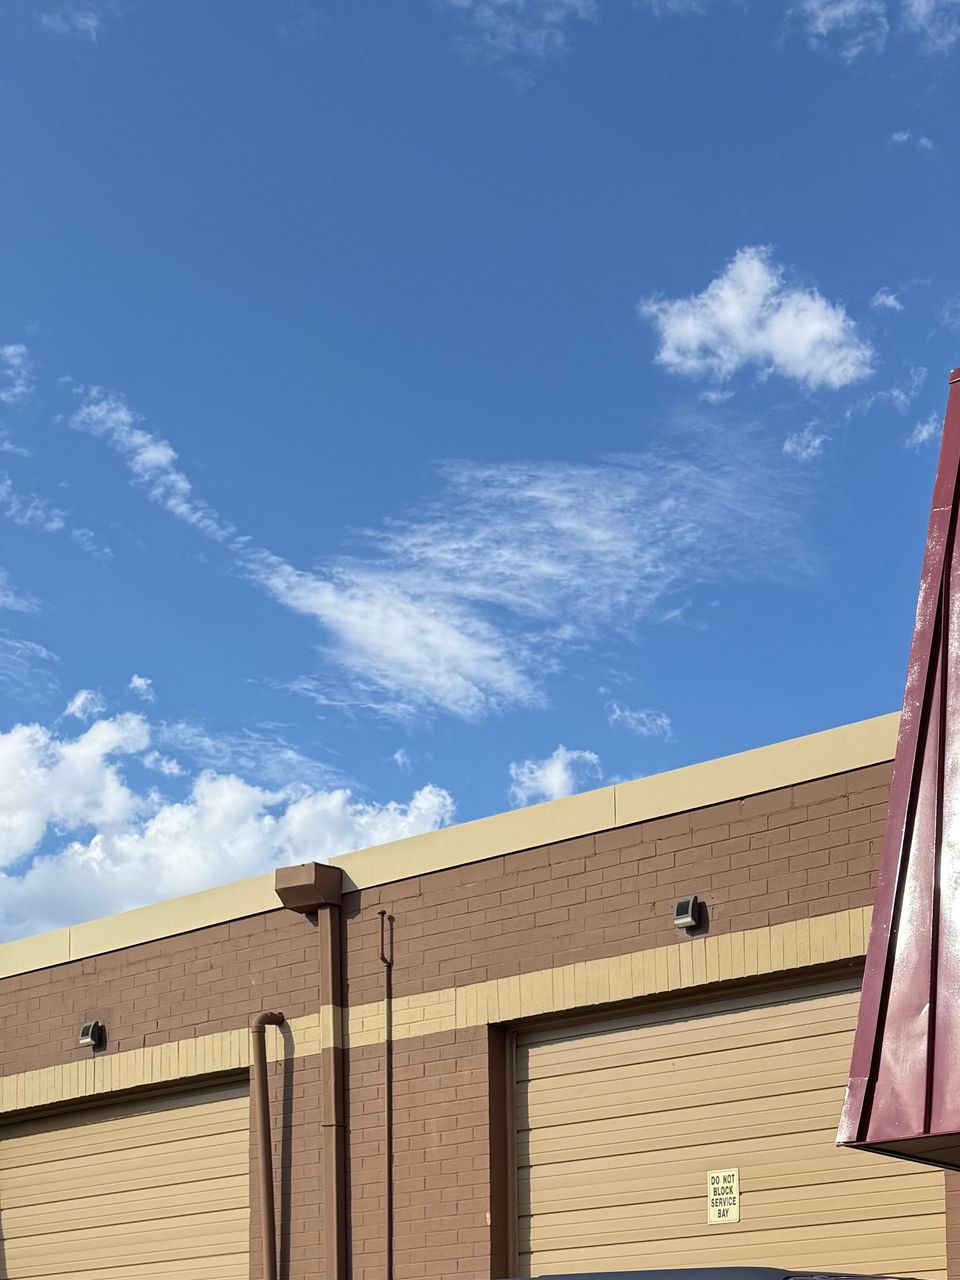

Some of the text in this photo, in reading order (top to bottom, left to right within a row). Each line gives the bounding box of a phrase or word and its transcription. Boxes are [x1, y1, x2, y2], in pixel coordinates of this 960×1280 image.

[711, 1174, 735, 1185] DO NOT
[713, 1186, 734, 1196] BLOCK
[711, 1197, 736, 1207] SERVICE
[718, 1208, 729, 1218] BAY
